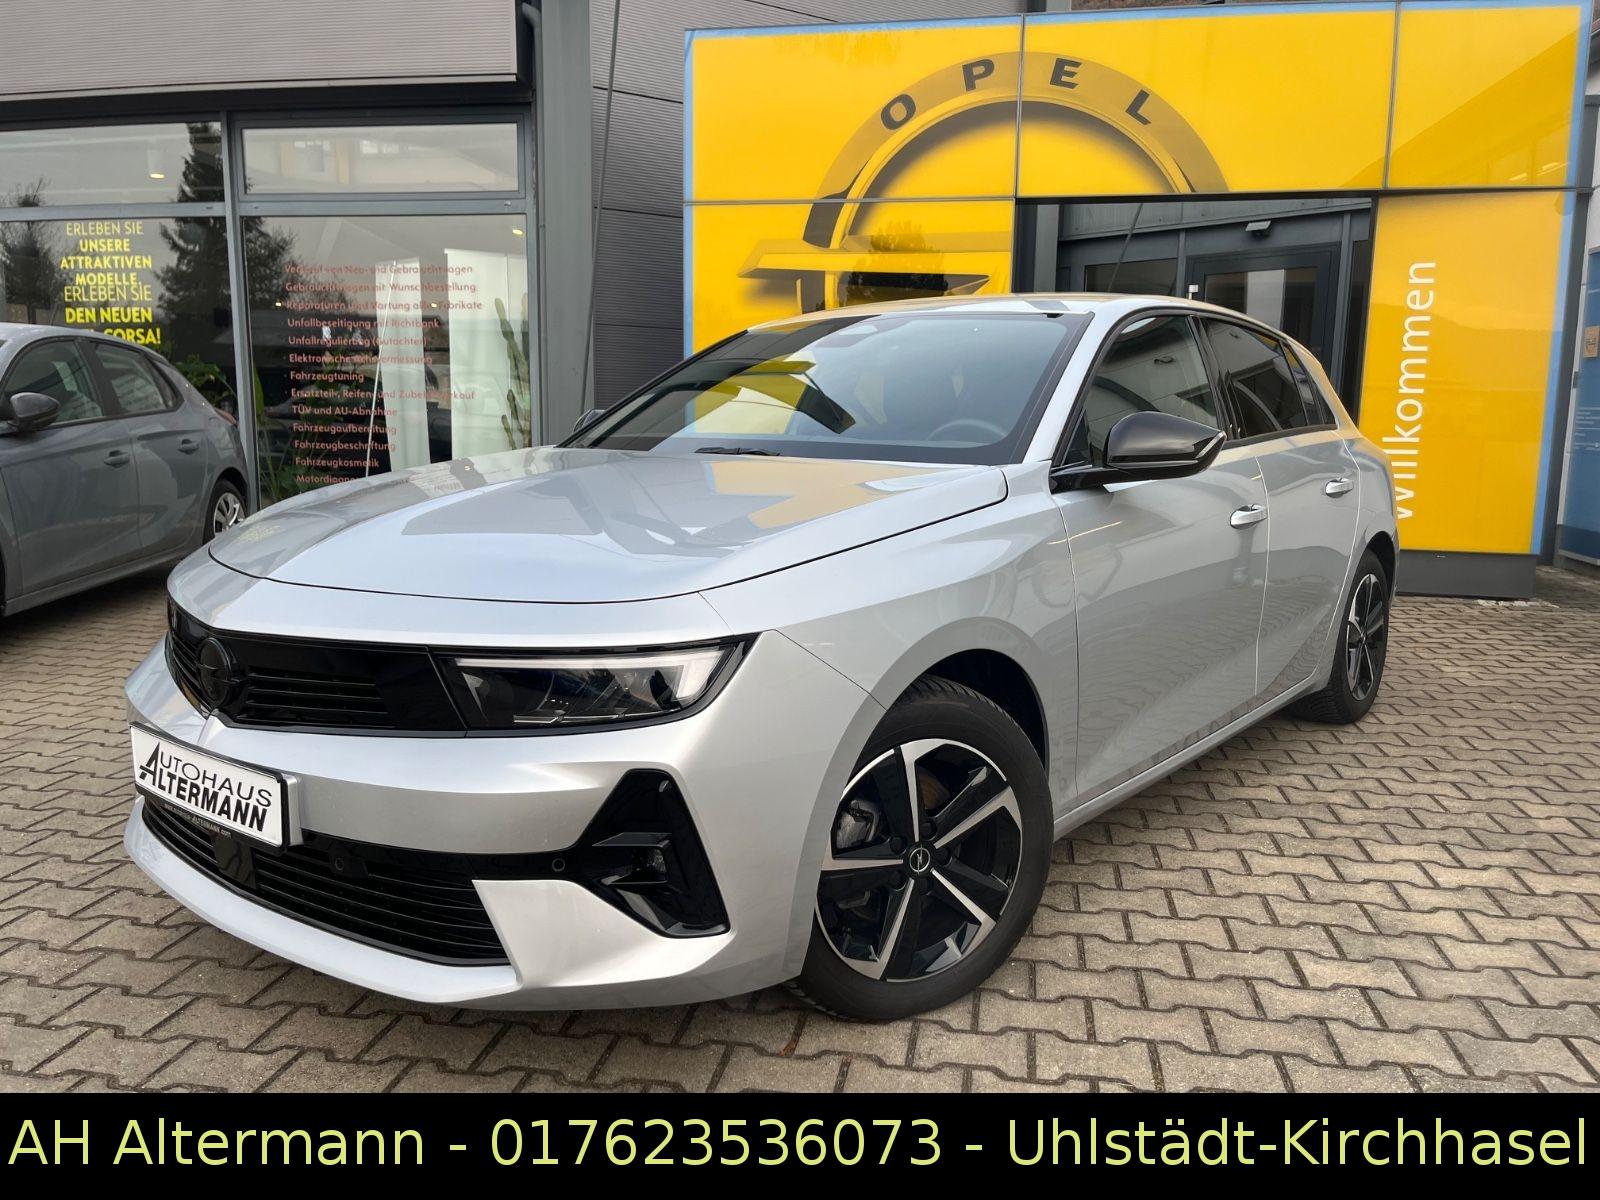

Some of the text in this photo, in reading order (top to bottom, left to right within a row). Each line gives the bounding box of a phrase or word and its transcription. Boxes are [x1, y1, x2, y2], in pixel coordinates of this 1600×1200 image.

[880, 57, 1152, 131] OPEL
[66, 221, 144, 235] ERLEBEN SIE
[79, 239, 131, 252] UNSERE
[60, 255, 152, 269] ATTRAKTIVEN
[369, 265, 387, 274] und
[390, 264, 473, 275] Gebrauchtwagen
[64, 285, 153, 301] ERLEBEN SIE
[285, 282, 477, 293] Gebrauchtwagen mit Wunschbestellung
[286, 301, 346, 311] Reparaturen
[348, 301, 370, 310] und
[371, 301, 410, 311] Wartung
[438, 301, 483, 310] Fabrikate
[65, 306, 153, 323] DEN NEUEN
[287, 318, 371, 329] Unfallbeseitigung
[391, 319, 440, 328] Richtbank
[288, 336, 427, 347] Unfallregulierung (Gutachten)
[289, 353, 350, 363] Elektronische
[290, 371, 365, 383] Fahrzeugtuning
[342, 388, 375, 399] Reifen-
[377, 389, 396, 399] und
[291, 404, 398, 416] TÜV und AU-Abnahme
[292, 423, 397, 435] Fahrzeugaufbereitung
[294, 440, 397, 452] Fahrzeugbeschriftung
[295, 457, 380, 469] Fahrzeugkosmetik
[139, 742, 273, 808] AUTOHAUS
[139, 742, 268, 832] ALTERMANN
